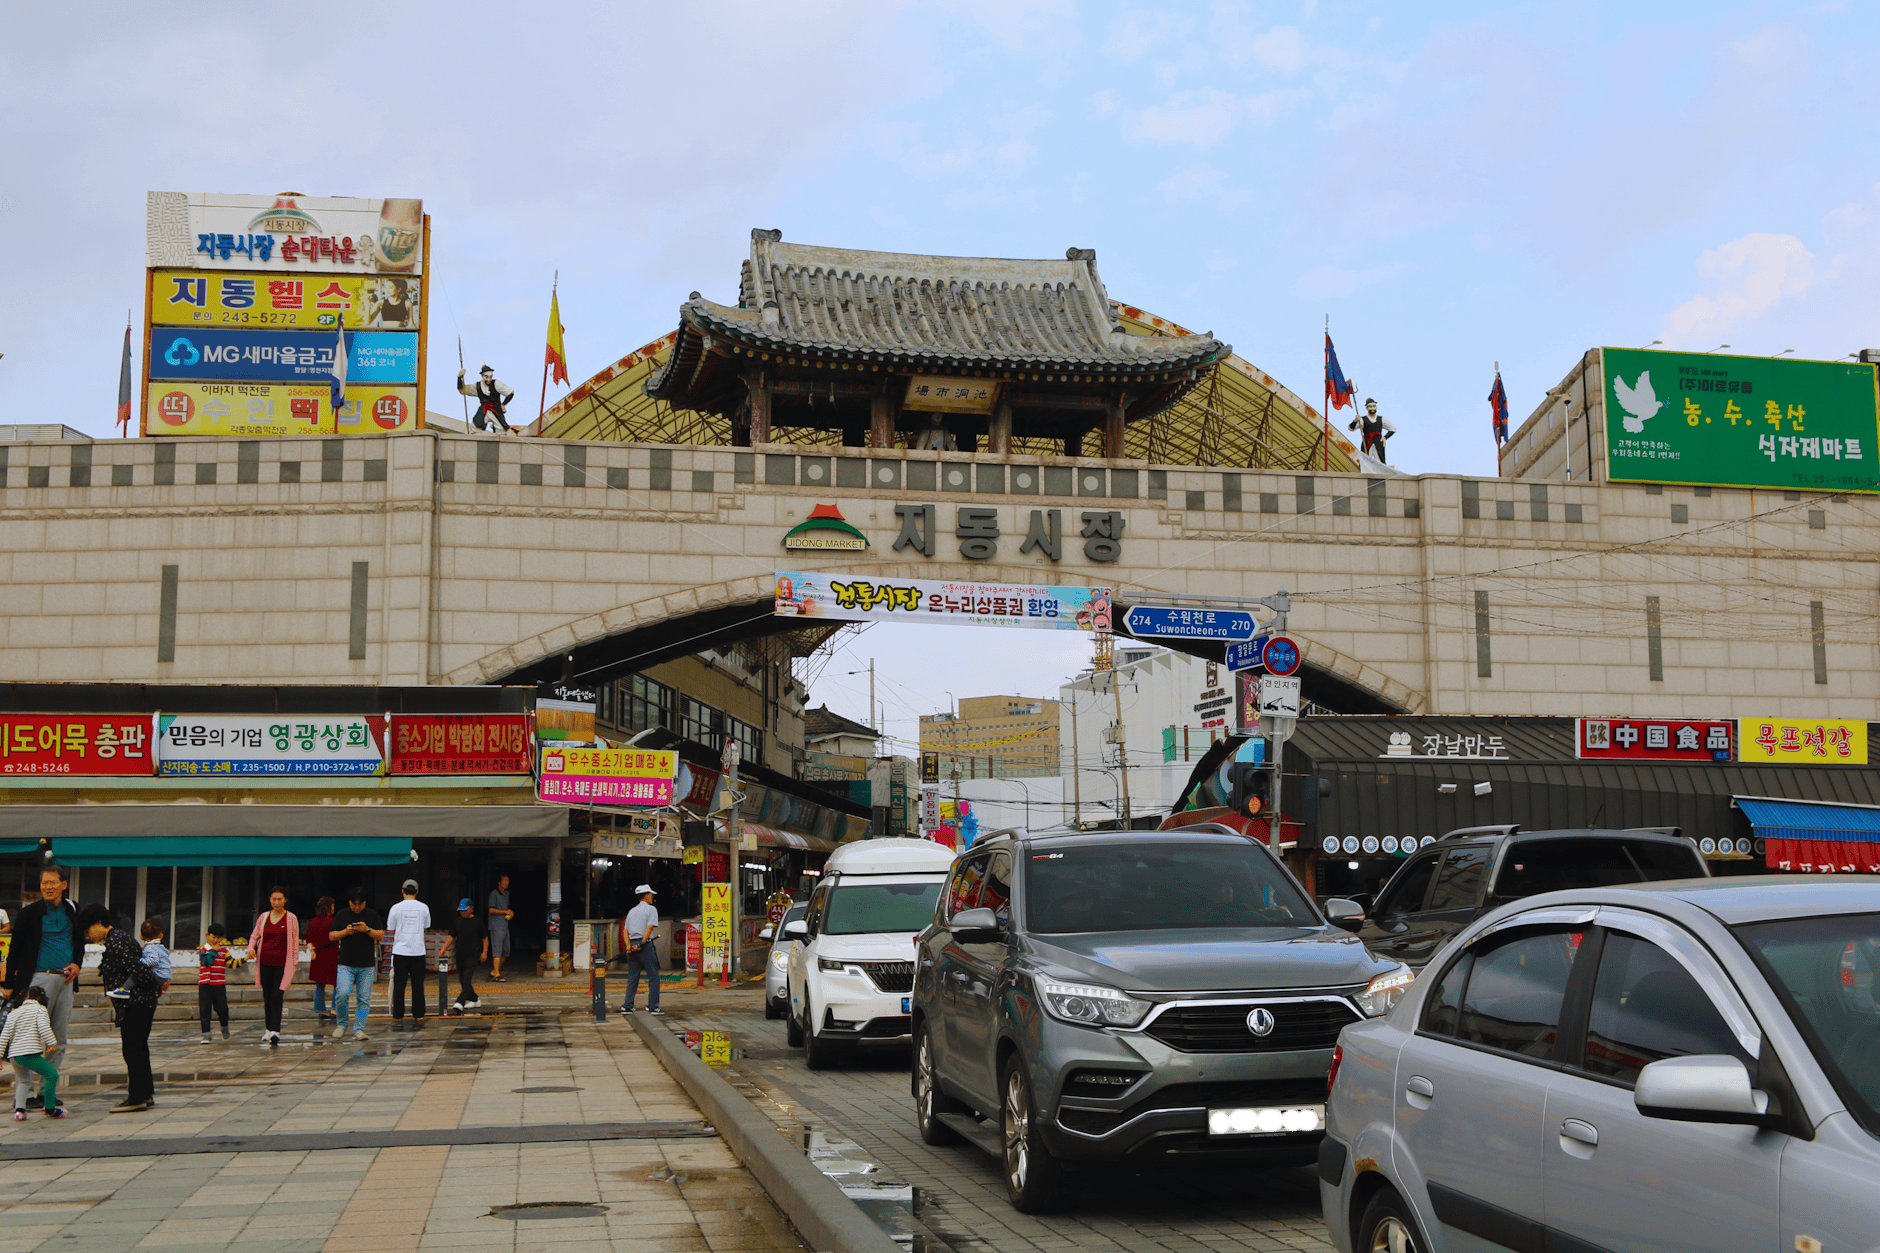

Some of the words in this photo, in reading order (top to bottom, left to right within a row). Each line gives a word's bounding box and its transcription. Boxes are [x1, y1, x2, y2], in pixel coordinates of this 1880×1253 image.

[265, 221, 305, 231] 지동시장
[197, 233, 275, 262] 지동시장
[281, 235, 357, 264] 순대타운
[169, 278, 255, 309] 지동
[222, 312, 297, 324] 243-5272
[319, 315, 334, 324] 2F
[358, 357, 371, 366] 365
[201, 385, 233, 396] 이바지
[238, 386, 271, 397] 떡전문
[162, 394, 187, 423] 떡
[376, 398, 401, 427] 떡
[1759, 434, 1862, 462] 식자재마트
[892, 503, 1126, 562] 지동시장
[787, 538, 823, 549] JIDONG
[825, 539, 864, 549] MARKET
[830, 581, 923, 611] 전통시장
[1015, 587, 1050, 596] 감사합니다
[929, 594, 1023, 616] 온누리상품권
[1028, 598, 1059, 618] 환영
[1132, 615, 1151, 626] 274
[1167, 610, 1217, 625] 수원천로
[1156, 624, 1228, 636] Suwoncheon-ro
[1231, 620, 1250, 631] 270
[1265, 680, 1298, 689] 견인지역
[94, 723, 146, 758] 총판
[168, 725, 225, 748] 믿음의
[231, 728, 262, 748] 기업
[268, 723, 371, 752] 영광상회
[397, 724, 446, 755] 중소기업
[449, 724, 485, 754] 박람회
[488, 723, 525, 754] 전시장
[1615, 723, 1730, 750] 中国食品
[1755, 724, 1853, 757] 목포젓갈
[1422, 733, 1506, 757] 장날만두
[16, 763, 70, 773] 248-5246
[242, 763, 285, 773] 235-1500
[313, 763, 380, 773] 010-3724-1501
[704, 886, 728, 898] TV
[704, 903, 729, 912] 홈쇼핑
[706, 917, 728, 929] 중소
[706, 931, 727, 944] 기업
[705, 945, 725, 958] 매장
